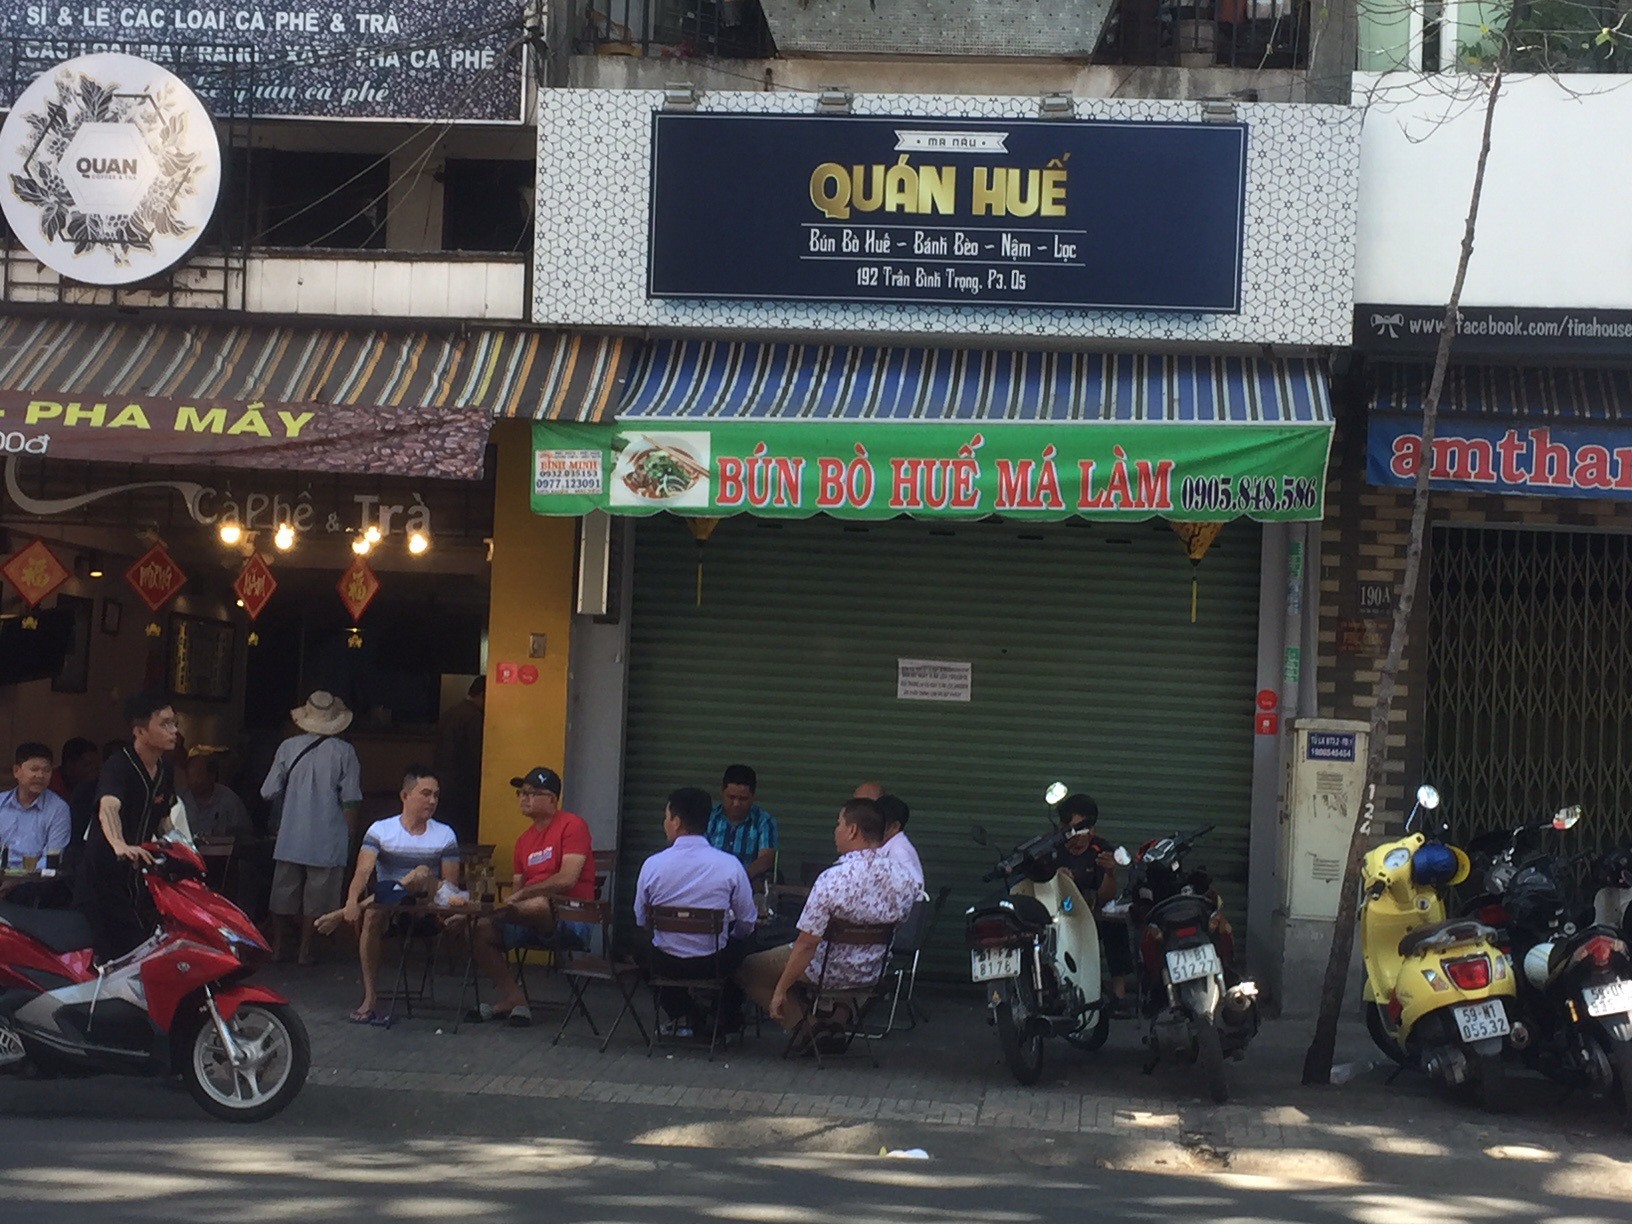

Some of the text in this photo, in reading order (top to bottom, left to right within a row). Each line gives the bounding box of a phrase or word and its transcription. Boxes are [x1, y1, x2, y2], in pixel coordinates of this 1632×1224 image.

[57, 6, 73, 26] &
[235, 6, 265, 30] CÀ
[275, 8, 319, 31] PHÊ
[330, 12, 346, 32] &
[356, 10, 400, 33] TRÀ
[304, 81, 333, 100] cà
[341, 80, 389, 106] phê
[809, 152, 1072, 220] QUÁN HUẾ
[809, 228, 836, 252] Bún
[841, 229, 860, 253] Bò
[913, 231, 948, 255] Bánh
[953, 232, 979, 256] Bèo
[1001, 232, 1031, 261] Nậm
[1053, 234, 1077, 262] Lọc
[856, 267, 879, 286] 192
[25, 400, 152, 429] PHA
[174, 401, 315, 438] MÁY
[569, 460, 598, 471] MINH
[716, 433, 1318, 512] BÚN BÒ HUẾ MÁ LÀM 0905.848.586
[325, 510, 340, 533] &
[353, 492, 431, 537] Trà
[1360, 586, 1391, 606] 190A
